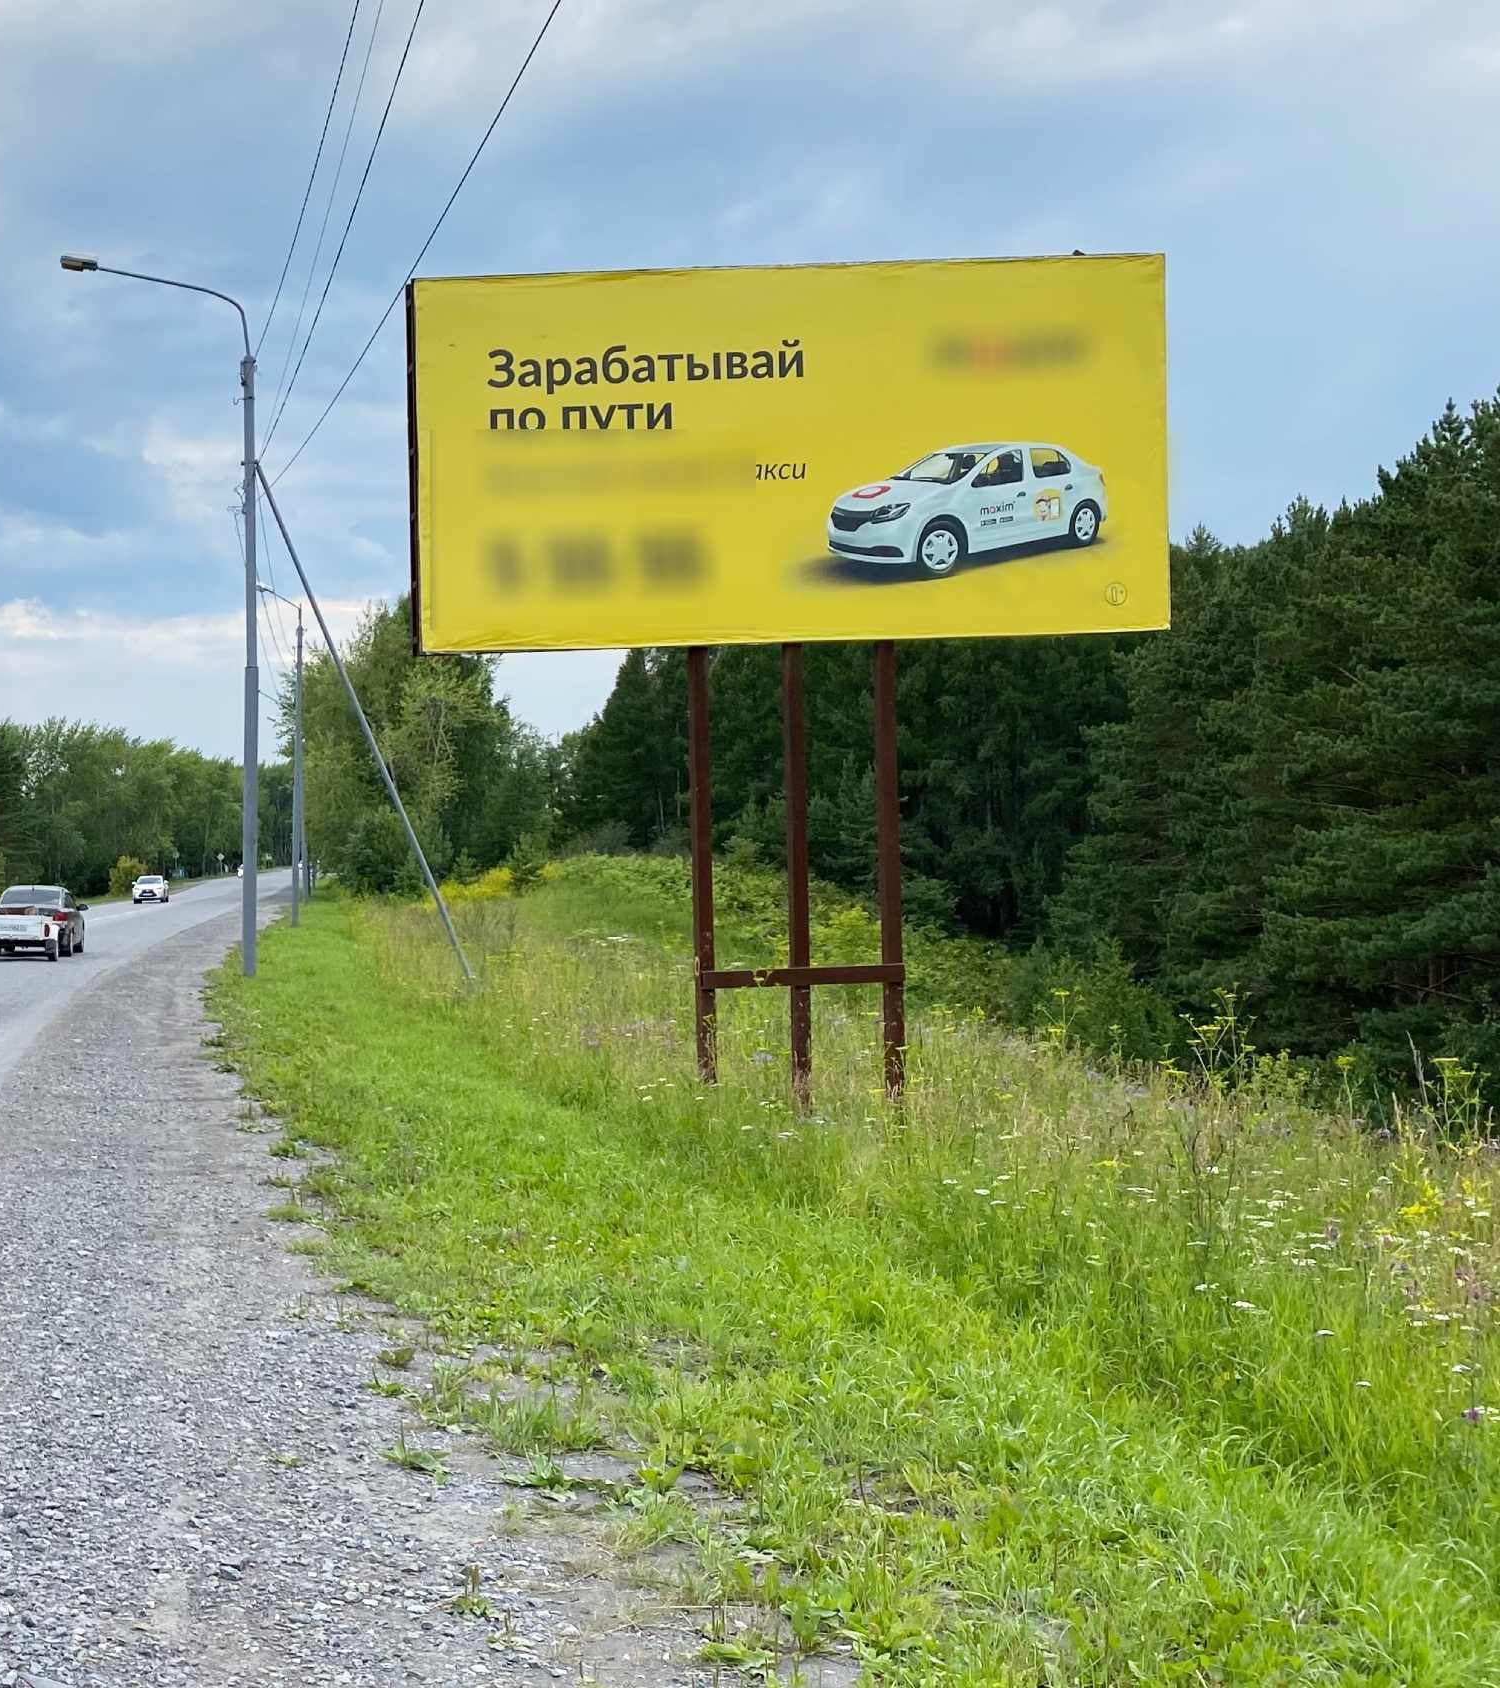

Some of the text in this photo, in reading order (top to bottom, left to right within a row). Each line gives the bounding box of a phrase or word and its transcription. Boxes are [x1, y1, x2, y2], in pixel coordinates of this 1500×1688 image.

[486, 339, 805, 395] Зарабатывай
[489, 402, 673, 430] по пути
